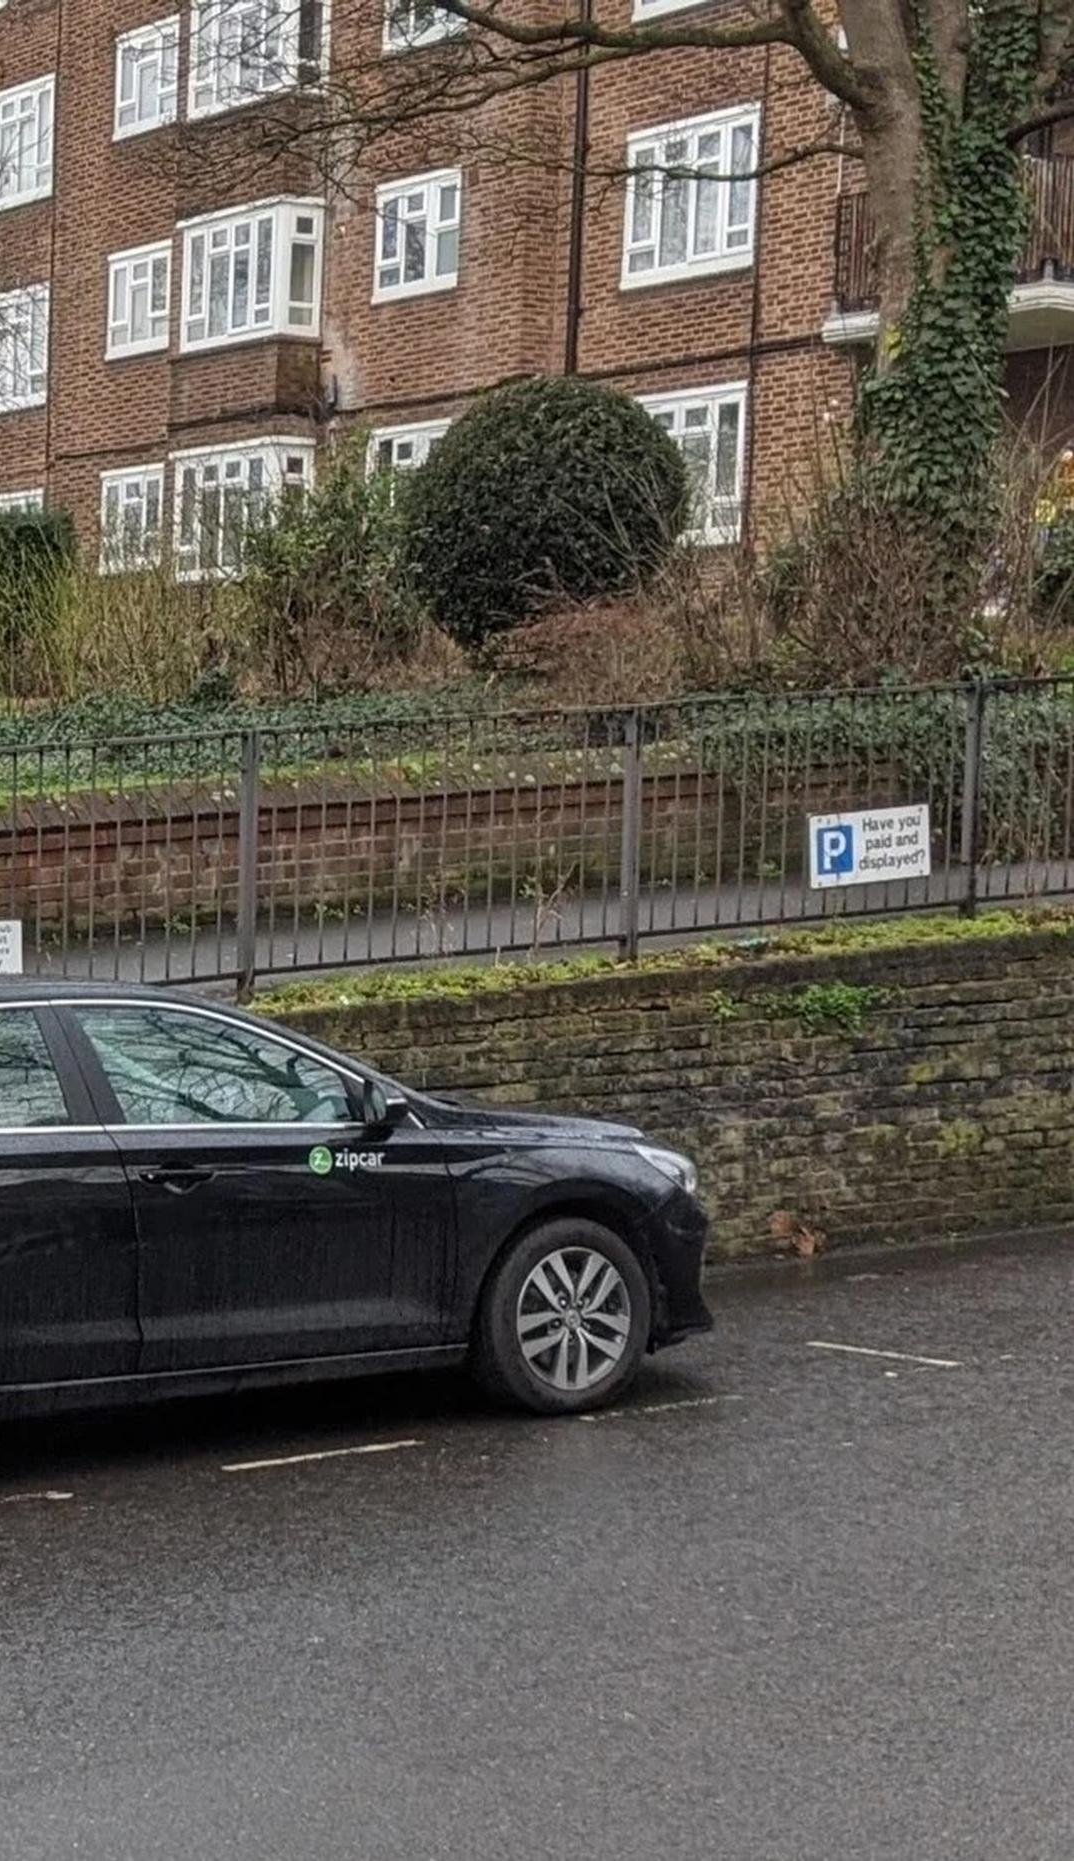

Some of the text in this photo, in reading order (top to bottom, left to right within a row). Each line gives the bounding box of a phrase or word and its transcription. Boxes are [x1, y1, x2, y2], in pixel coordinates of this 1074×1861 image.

[862, 815, 921, 832] Have you
[823, 830, 846, 870] P
[865, 830, 919, 852] paid and
[858, 849, 926, 872] displayed?
[334, 1147, 386, 1172] zipcar
